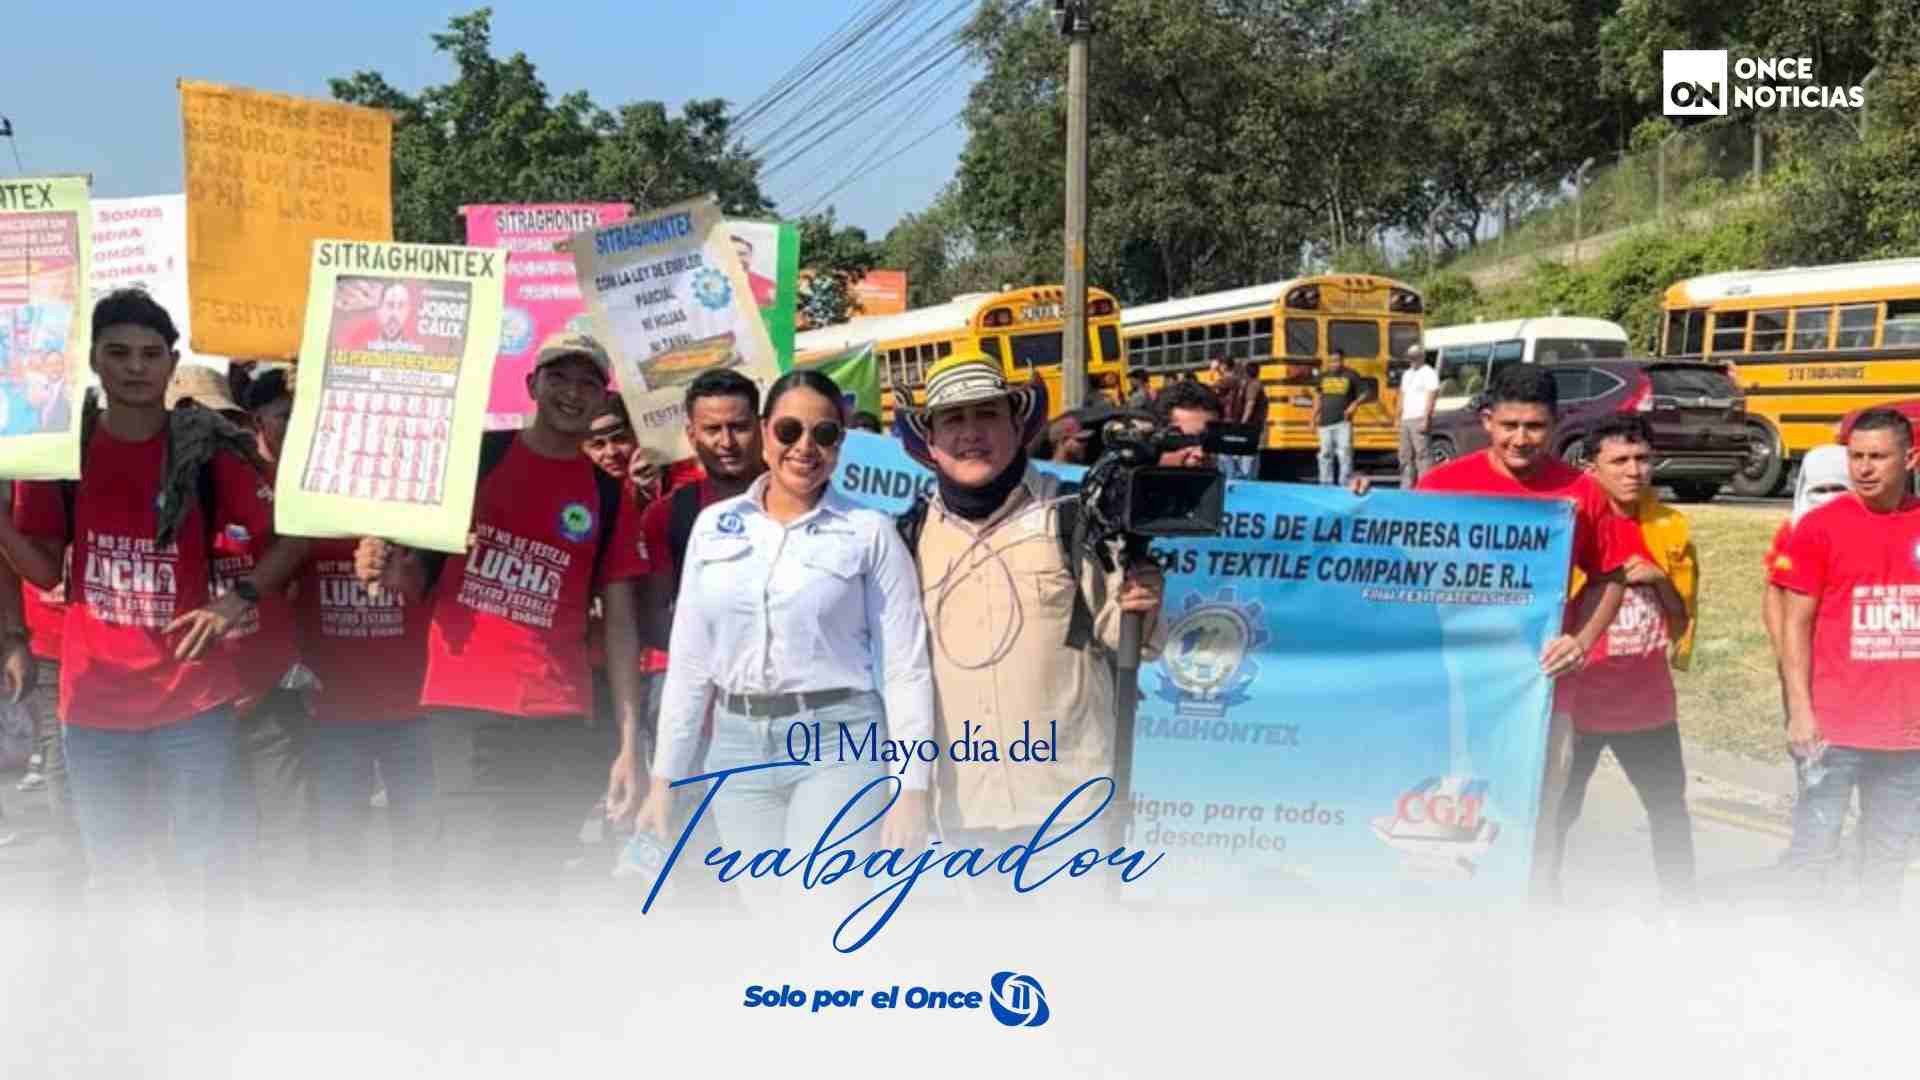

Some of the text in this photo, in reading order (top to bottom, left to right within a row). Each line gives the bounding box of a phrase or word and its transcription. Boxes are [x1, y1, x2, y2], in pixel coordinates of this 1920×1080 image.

[594, 211, 694, 257] SITRAGHONTEX
[318, 243, 495, 278] SITRAGHONTEX
[618, 271, 631, 287] LA
[632, 265, 651, 283] LEY
[1217, 513, 1550, 550] RES DE LA EMPRESA GILDAN
[1150, 548, 1534, 588] RAS TEXTILE COMPANY S.DE R.L
[1137, 717, 1299, 747] RAGHONTEX
[1204, 801, 1264, 824] para
[1274, 801, 1345, 826] todos
[1144, 823, 1287, 854] desempleo
